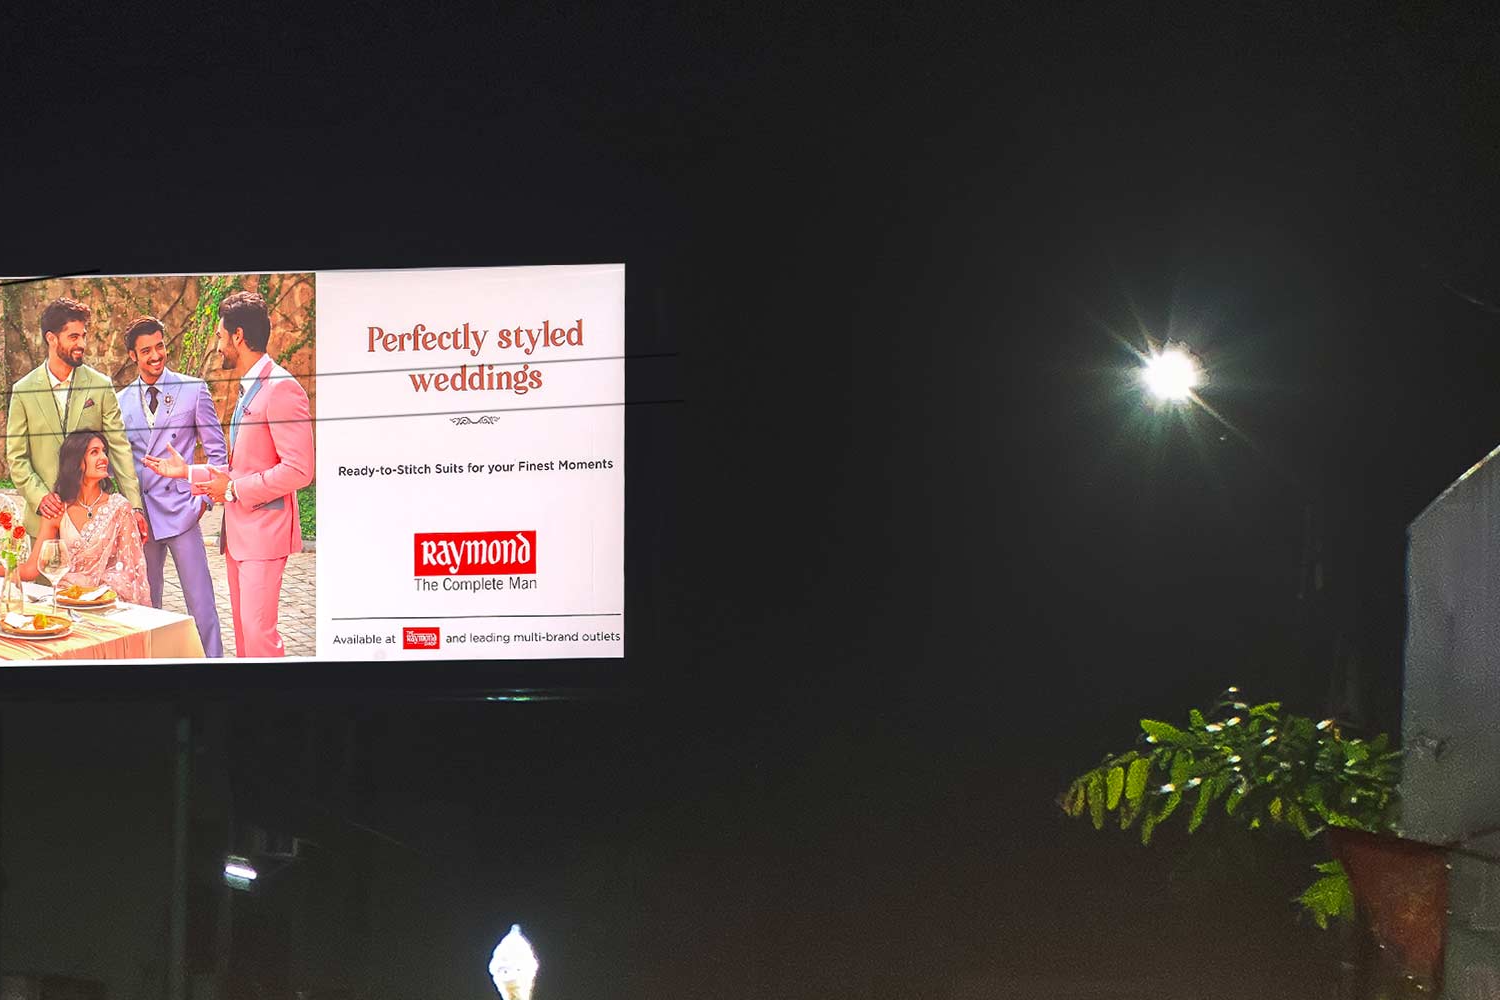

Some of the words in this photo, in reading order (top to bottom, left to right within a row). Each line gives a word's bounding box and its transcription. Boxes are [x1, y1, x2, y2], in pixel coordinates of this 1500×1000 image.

[368, 323, 488, 356] Perfectly
[498, 319, 583, 355] styled
[409, 363, 543, 395] weddings
[339, 464, 431, 477] Ready-to-Stitch
[435, 464, 464, 473] Suits
[468, 463, 484, 473] for
[488, 464, 514, 474] your
[519, 461, 554, 471] Finest
[559, 459, 613, 470] Moments
[421, 533, 531, 573] Raymond
[414, 576, 438, 591] The
[443, 578, 503, 593] Complete
[510, 577, 537, 590] Man
[333, 635, 382, 644] Available
[386, 635, 396, 644] at
[446, 634, 466, 643] and
[470, 633, 510, 643] leading
[514, 632, 578, 641] multi-brand
[582, 632, 620, 641] outlets
